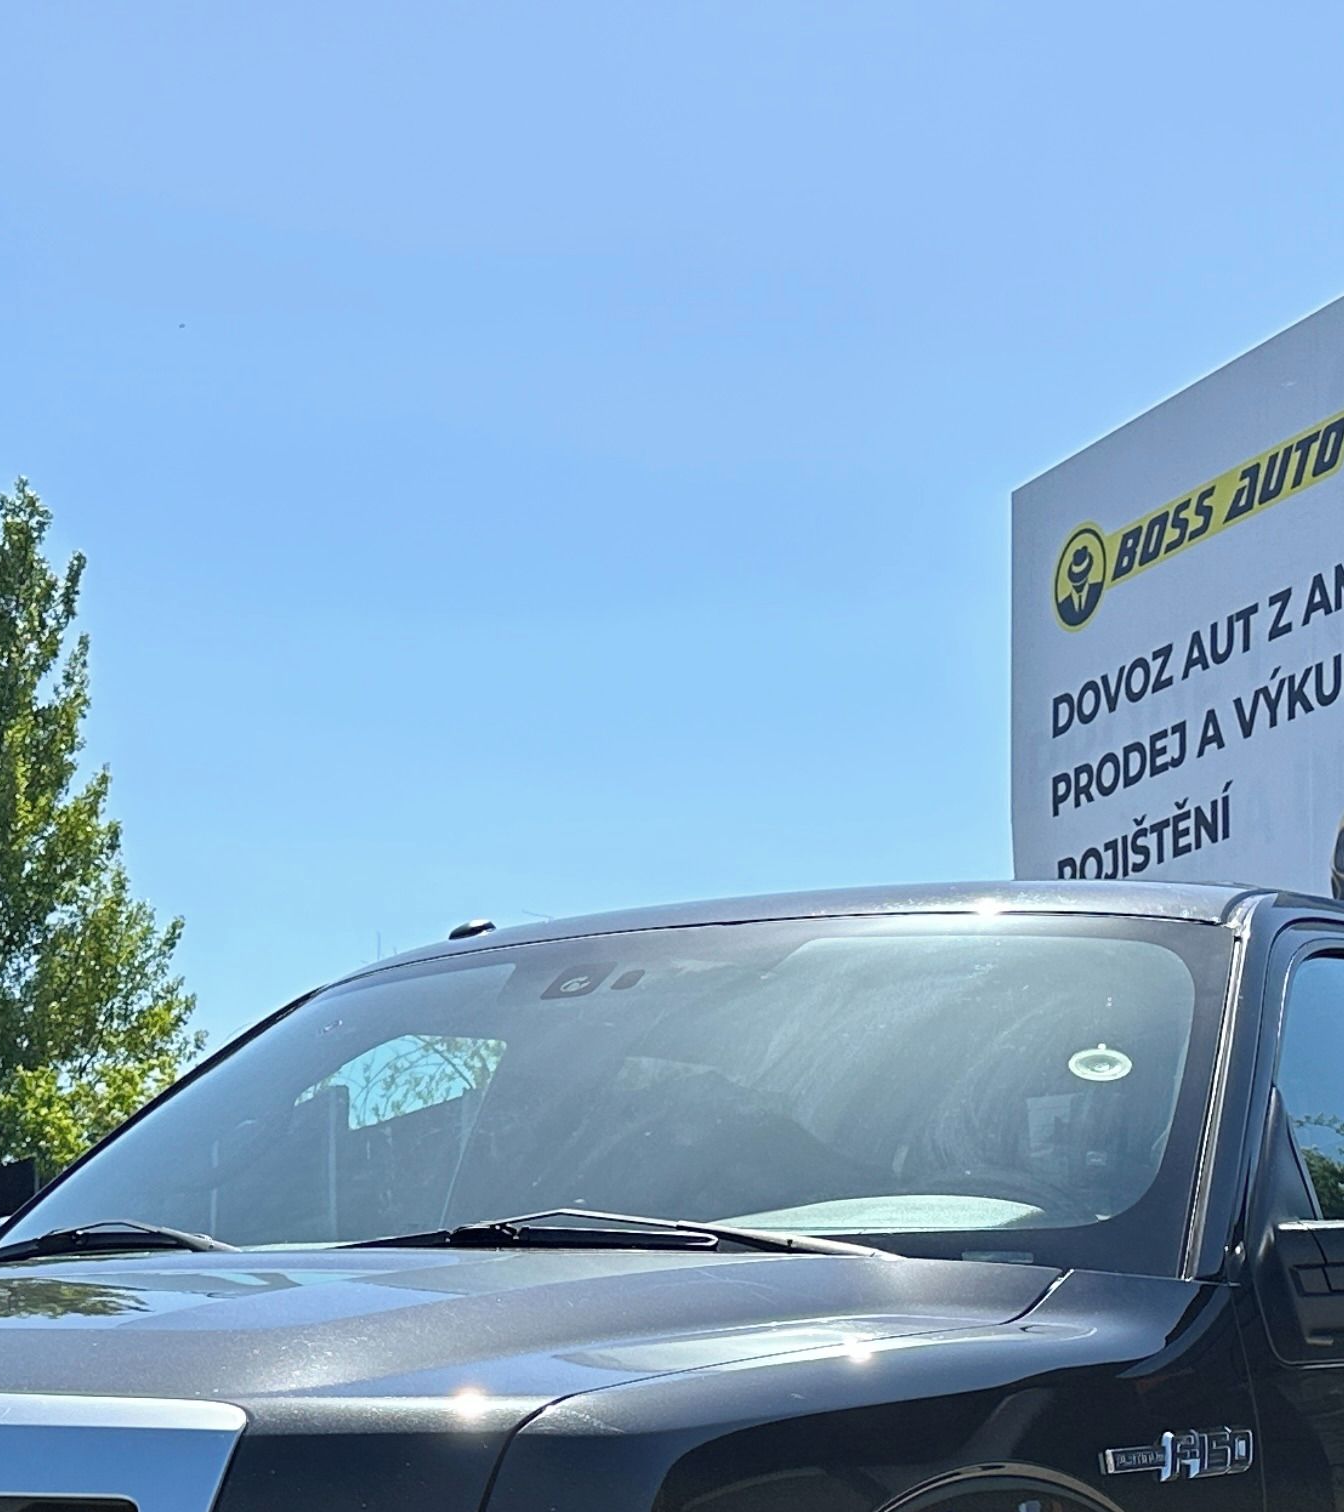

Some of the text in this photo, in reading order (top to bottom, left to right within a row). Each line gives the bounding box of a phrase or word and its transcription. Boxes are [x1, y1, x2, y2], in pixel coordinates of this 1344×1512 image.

[1110, 485, 1216, 582] BOSS
[1051, 642, 1174, 739] DOVOZ
[1180, 602, 1259, 679] AUT
[1268, 586, 1293, 643] Z
[1052, 720, 1188, 817] PRODEJ
[1196, 707, 1226, 759] A
